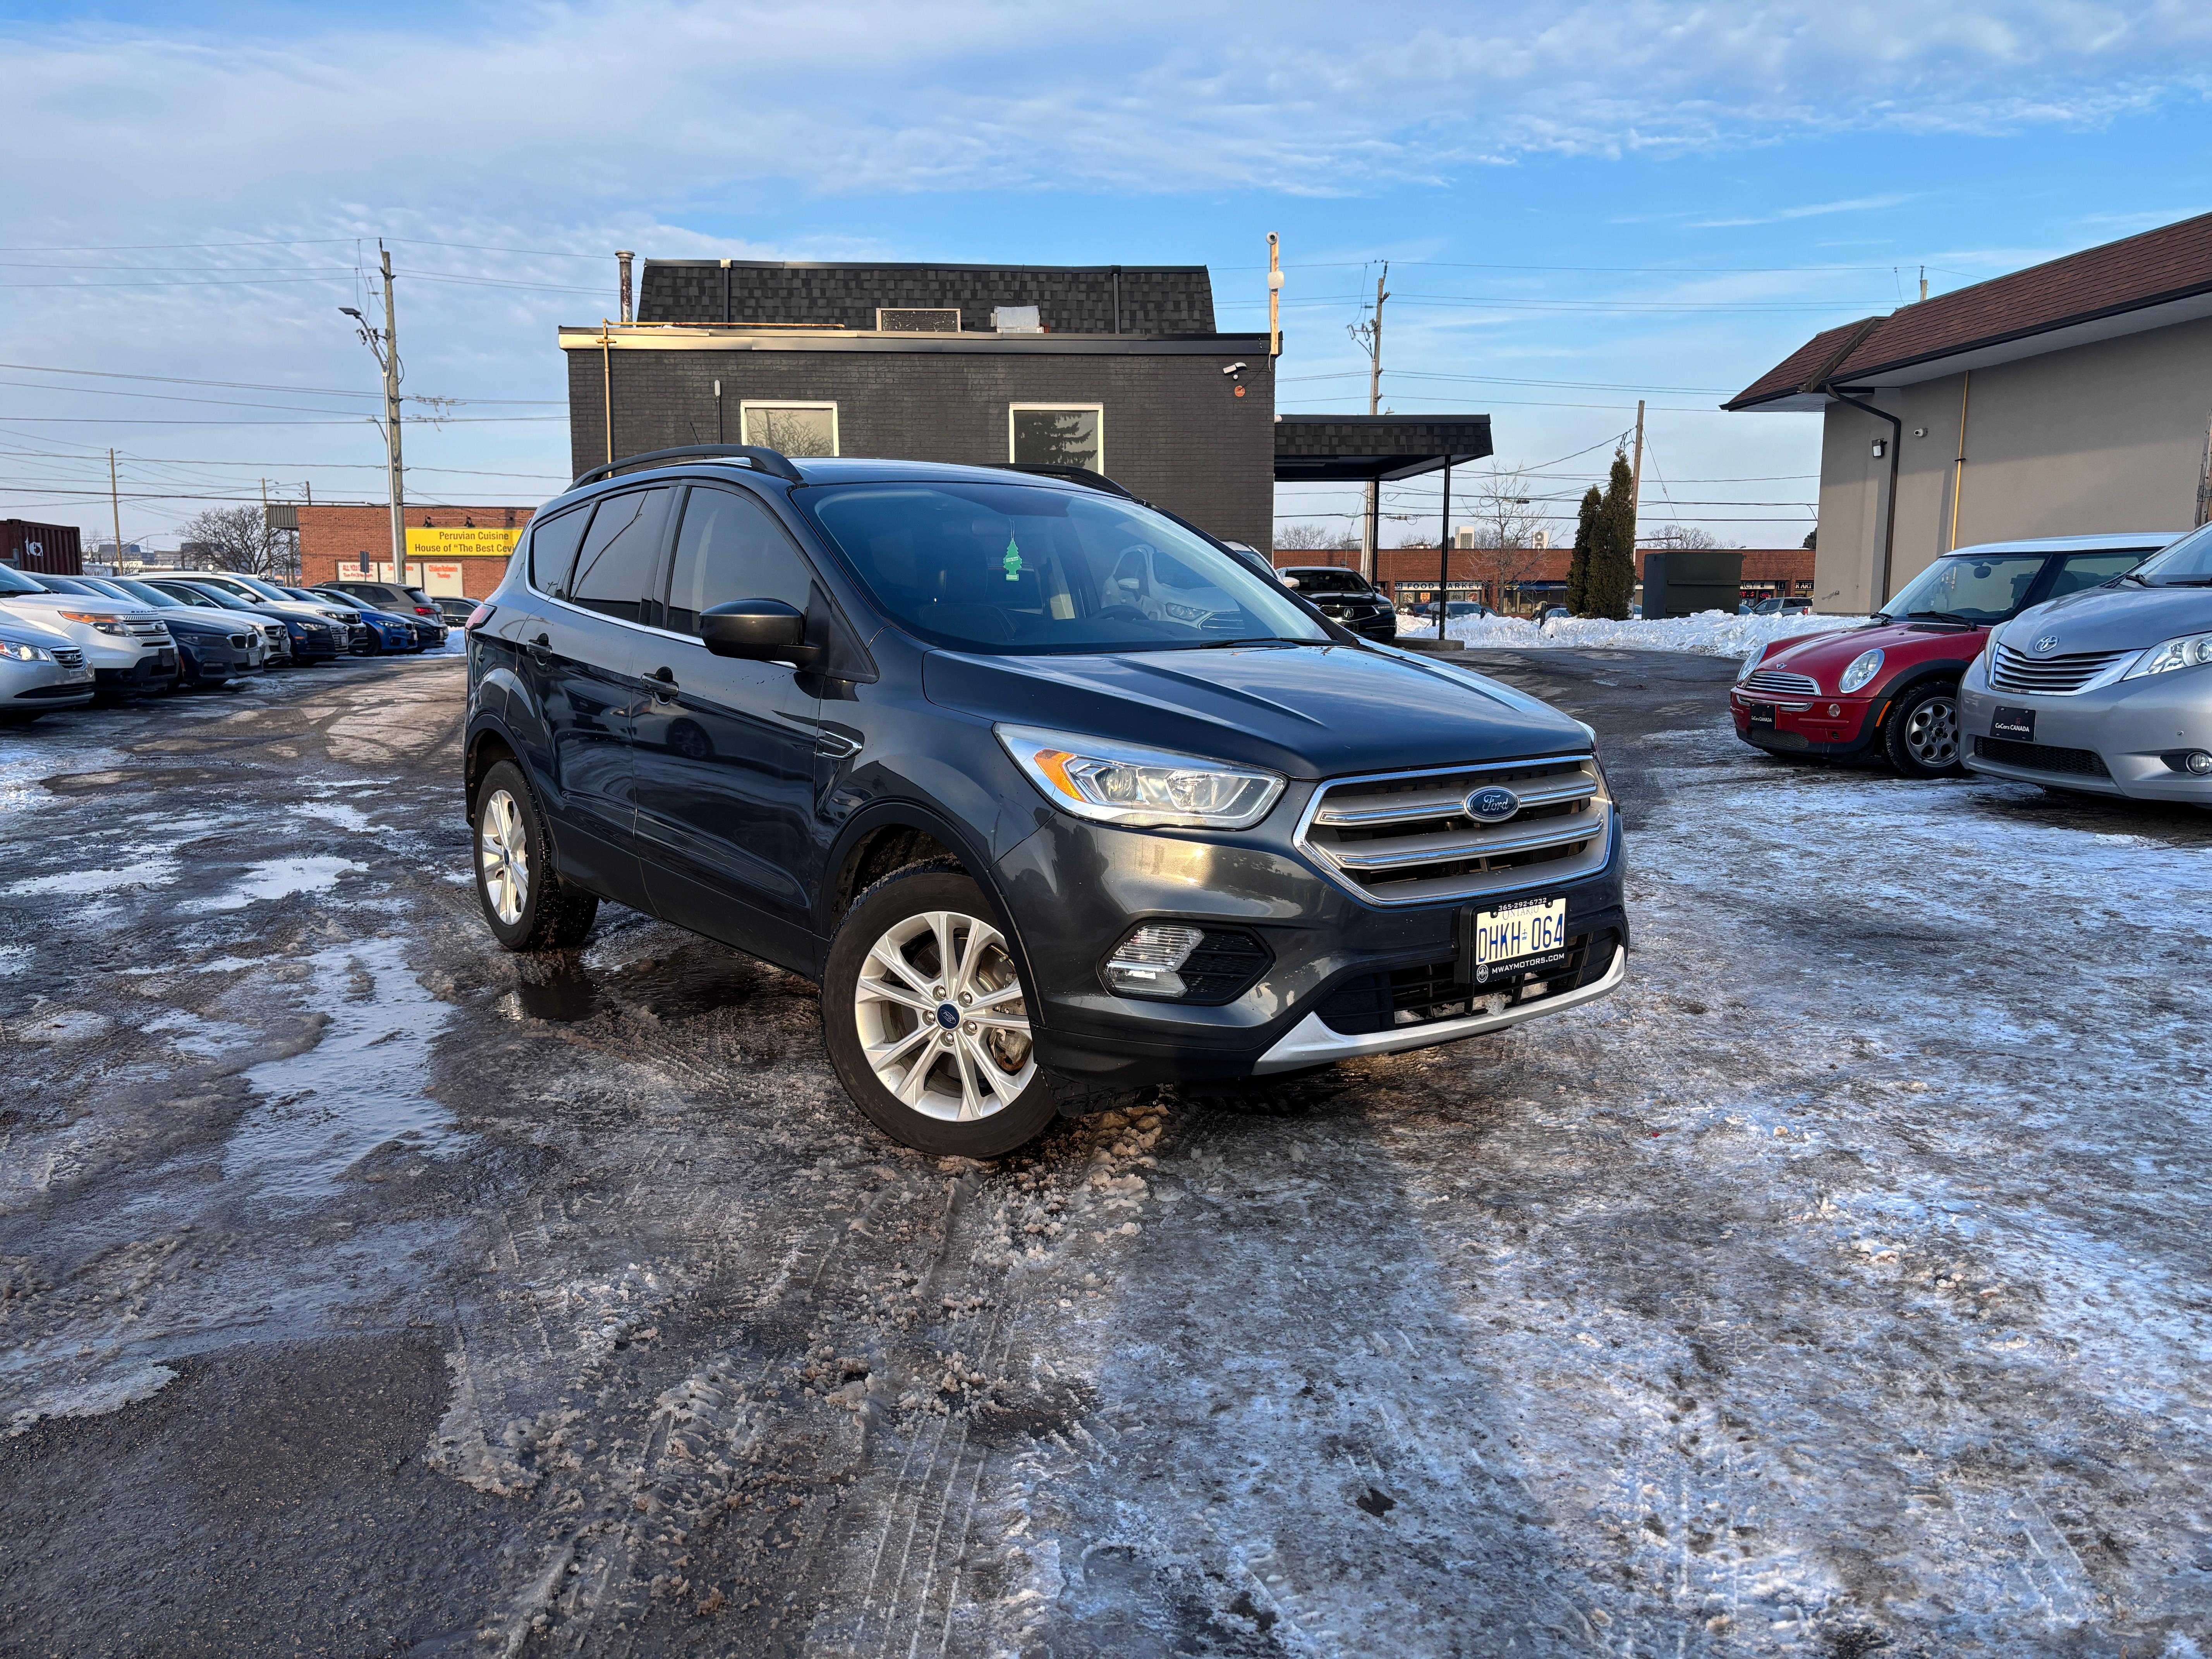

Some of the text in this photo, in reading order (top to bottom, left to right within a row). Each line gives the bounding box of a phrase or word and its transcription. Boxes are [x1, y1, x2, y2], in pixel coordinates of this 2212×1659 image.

[440, 532, 509, 540] Peruvian Cuisine
[415, 544, 441, 552] House
[443, 544, 452, 552] of
[476, 544, 494, 552] Best
[1482, 795, 1509, 811] Ford
[1503, 905, 1539, 920] ONTARIO
[1479, 913, 1563, 963] DHKH 064
[1492, 953, 1565, 974] MWAYMOTORS.COM
[943, 1011, 954, 1022] Ford
